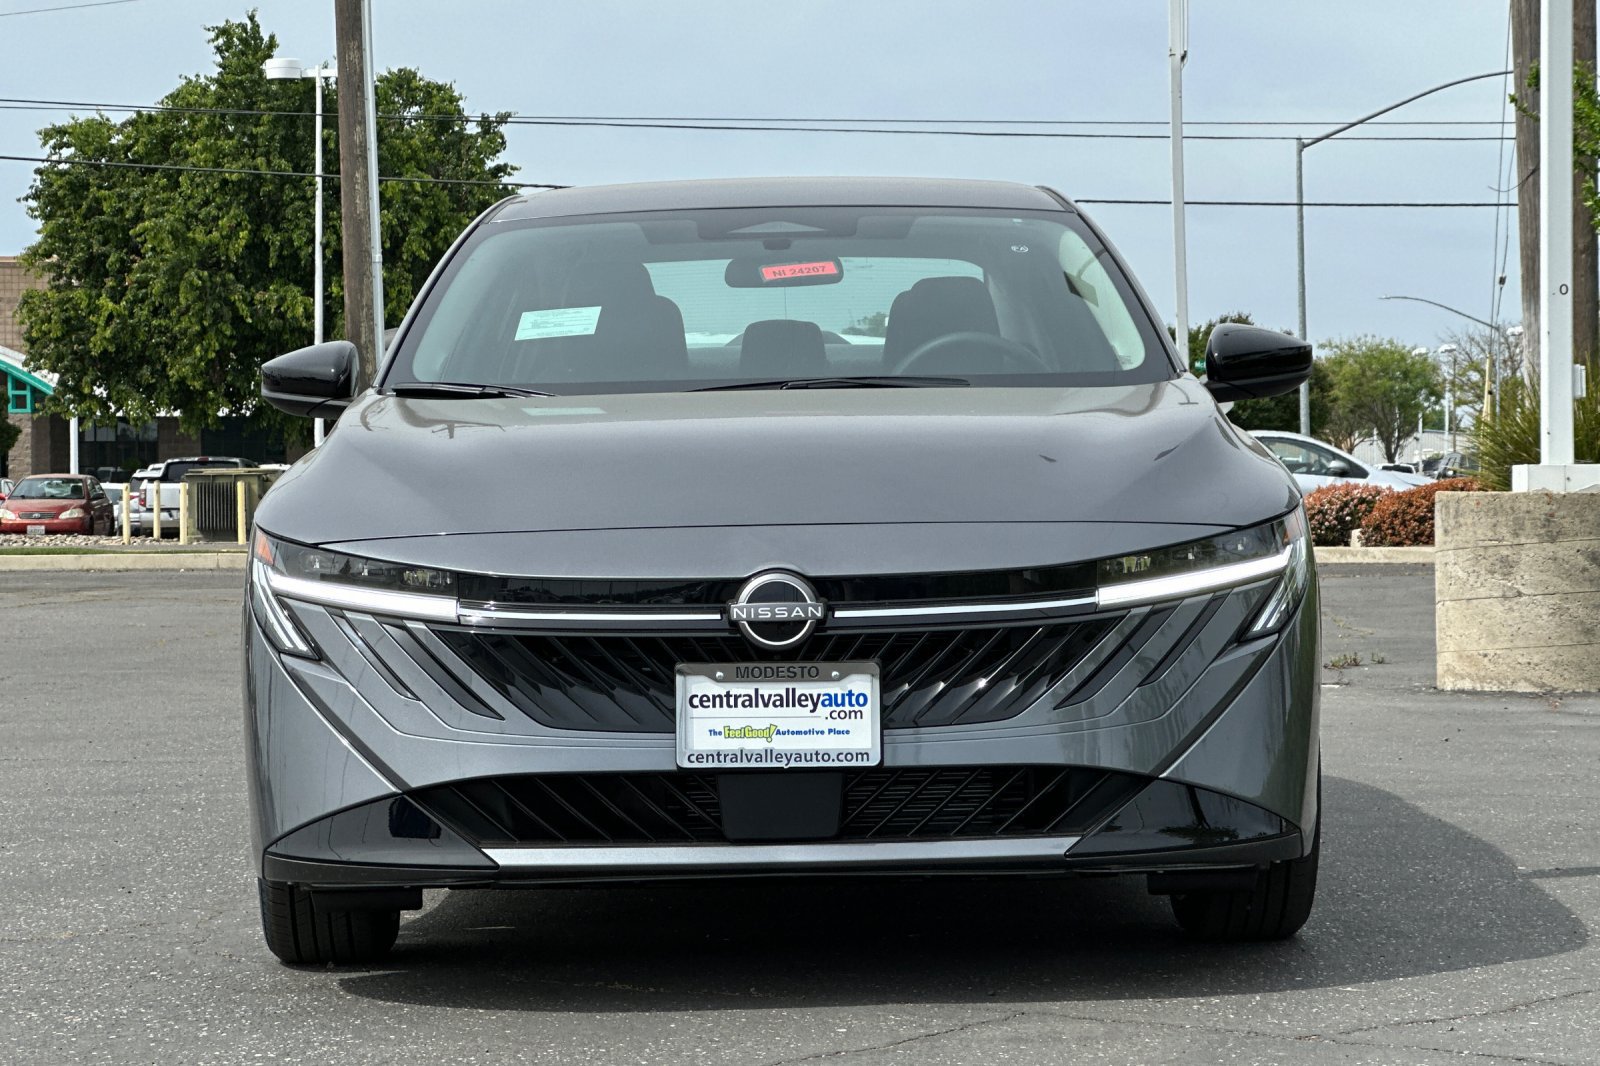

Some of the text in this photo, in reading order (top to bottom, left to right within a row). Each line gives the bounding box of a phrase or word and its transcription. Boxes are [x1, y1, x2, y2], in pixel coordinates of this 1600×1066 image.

[789, 265, 826, 276] 24207
[733, 606, 822, 618] NISSAN
[735, 666, 820, 679] MODESTO
[688, 687, 868, 713] centralvalleyauto
[825, 709, 863, 720] .com
[775, 728, 825, 736] Automotive
[827, 728, 851, 736] Place
[687, 749, 870, 767] centralvalleyauto.com
